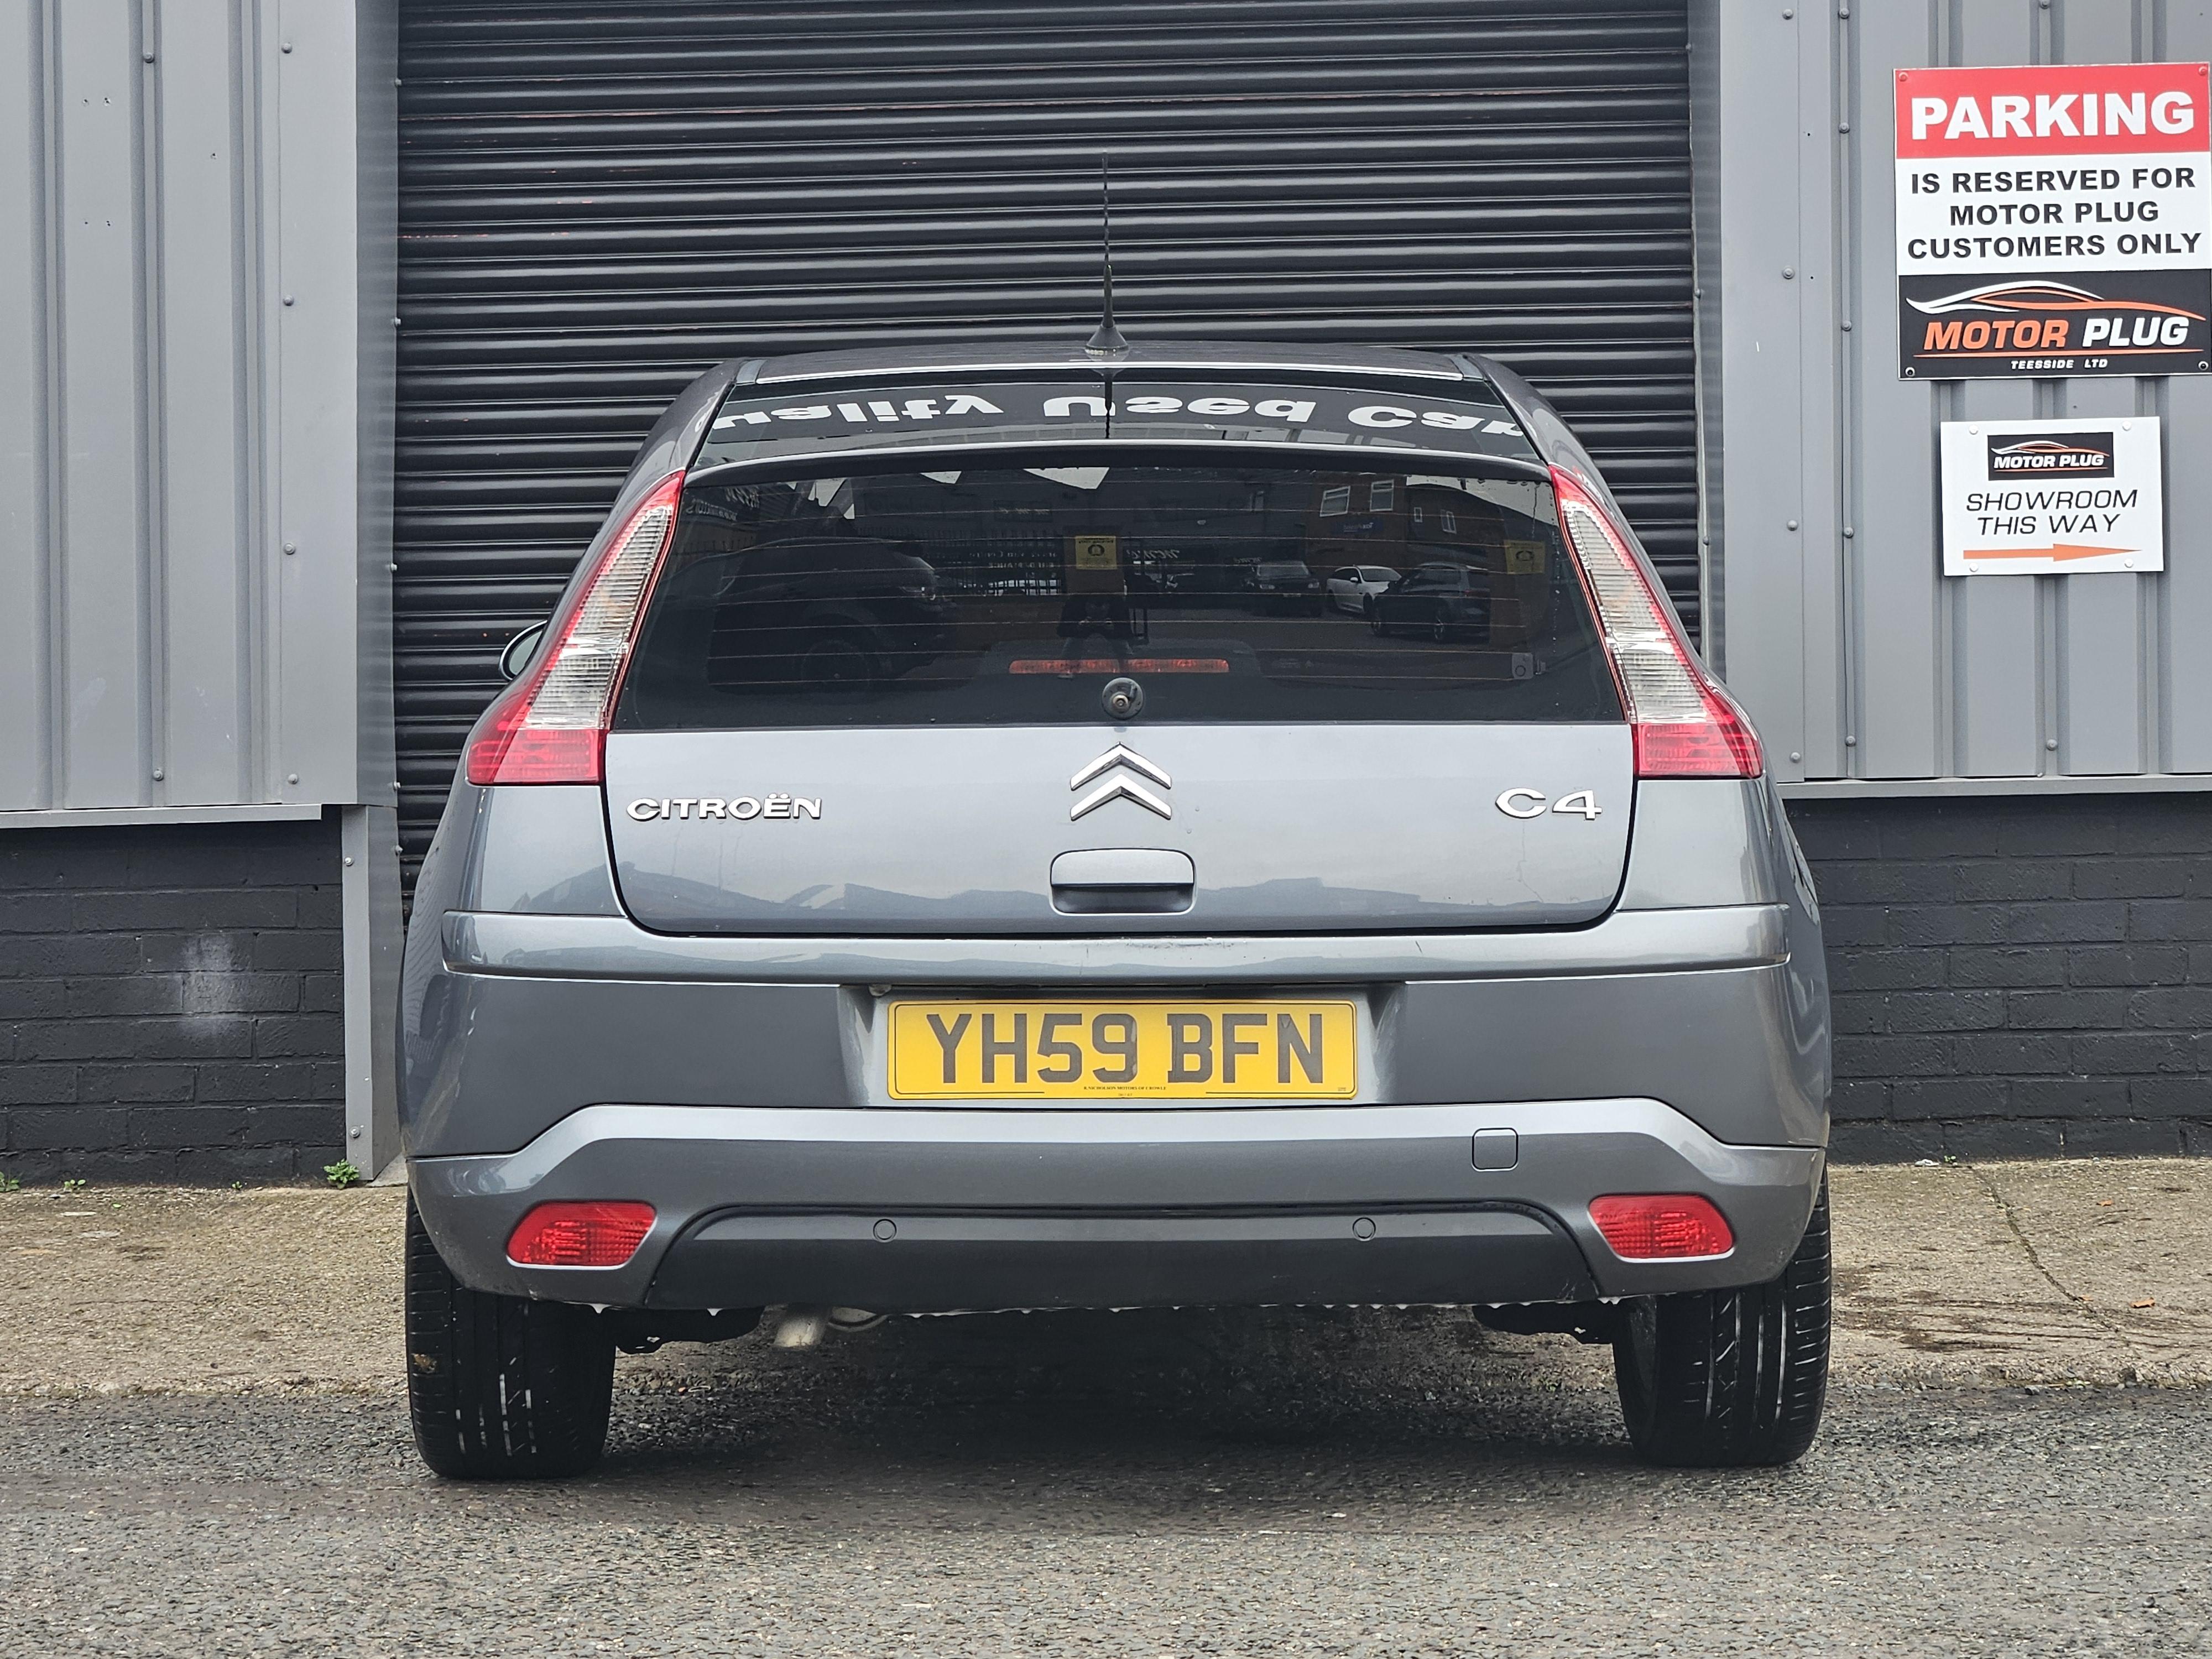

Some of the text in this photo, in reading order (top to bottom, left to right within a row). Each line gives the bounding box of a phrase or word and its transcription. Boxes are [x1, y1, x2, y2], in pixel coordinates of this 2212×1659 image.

[1911, 91, 2194, 140] PARKING
[1912, 168, 2195, 194] IS RESERVED FOR
[1950, 201, 2159, 226] MOTOR PLUG
[1908, 232, 2201, 259] CUSTOMERS ONLY
[1923, 316, 2189, 350] MOTOR PLUG
[2011, 358, 2108, 369] TEESSIDE LTD
[1994, 454, 2104, 469] MOTOR PLUG
[1966, 489, 2138, 512] SHOWROOM
[1978, 514, 2121, 535] THIS WAY
[626, 793, 822, 821] CITROËN
[1495, 787, 1603, 820] C4
[926, 1013, 1323, 1084] YH59 BFN
